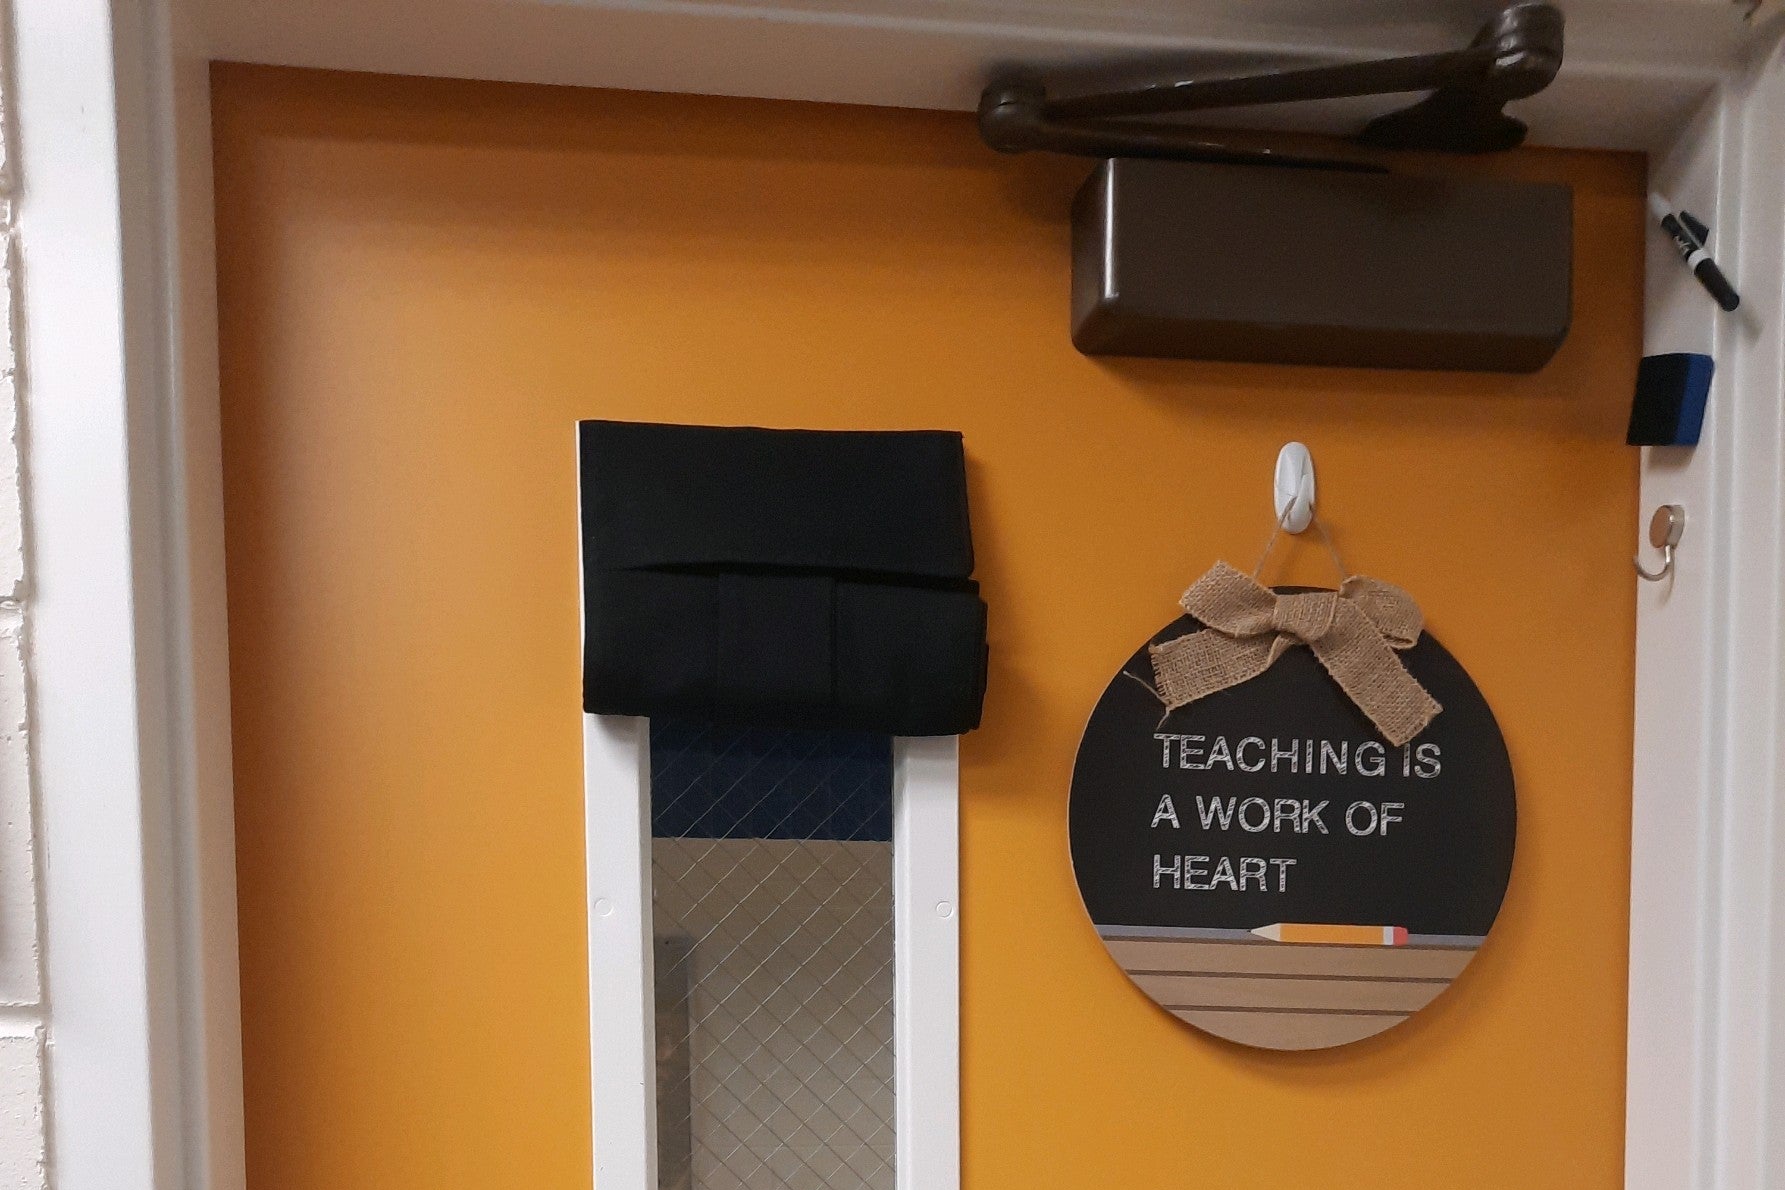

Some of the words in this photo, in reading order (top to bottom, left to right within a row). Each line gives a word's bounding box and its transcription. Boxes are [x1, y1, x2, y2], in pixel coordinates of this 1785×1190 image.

[1153, 733, 1386, 777] TEACHING
[1402, 743, 1441, 778] IS
[1151, 794, 1180, 829] A
[1196, 795, 1330, 834] WORK
[1345, 801, 1405, 835] OF
[1153, 854, 1297, 892] HEART
